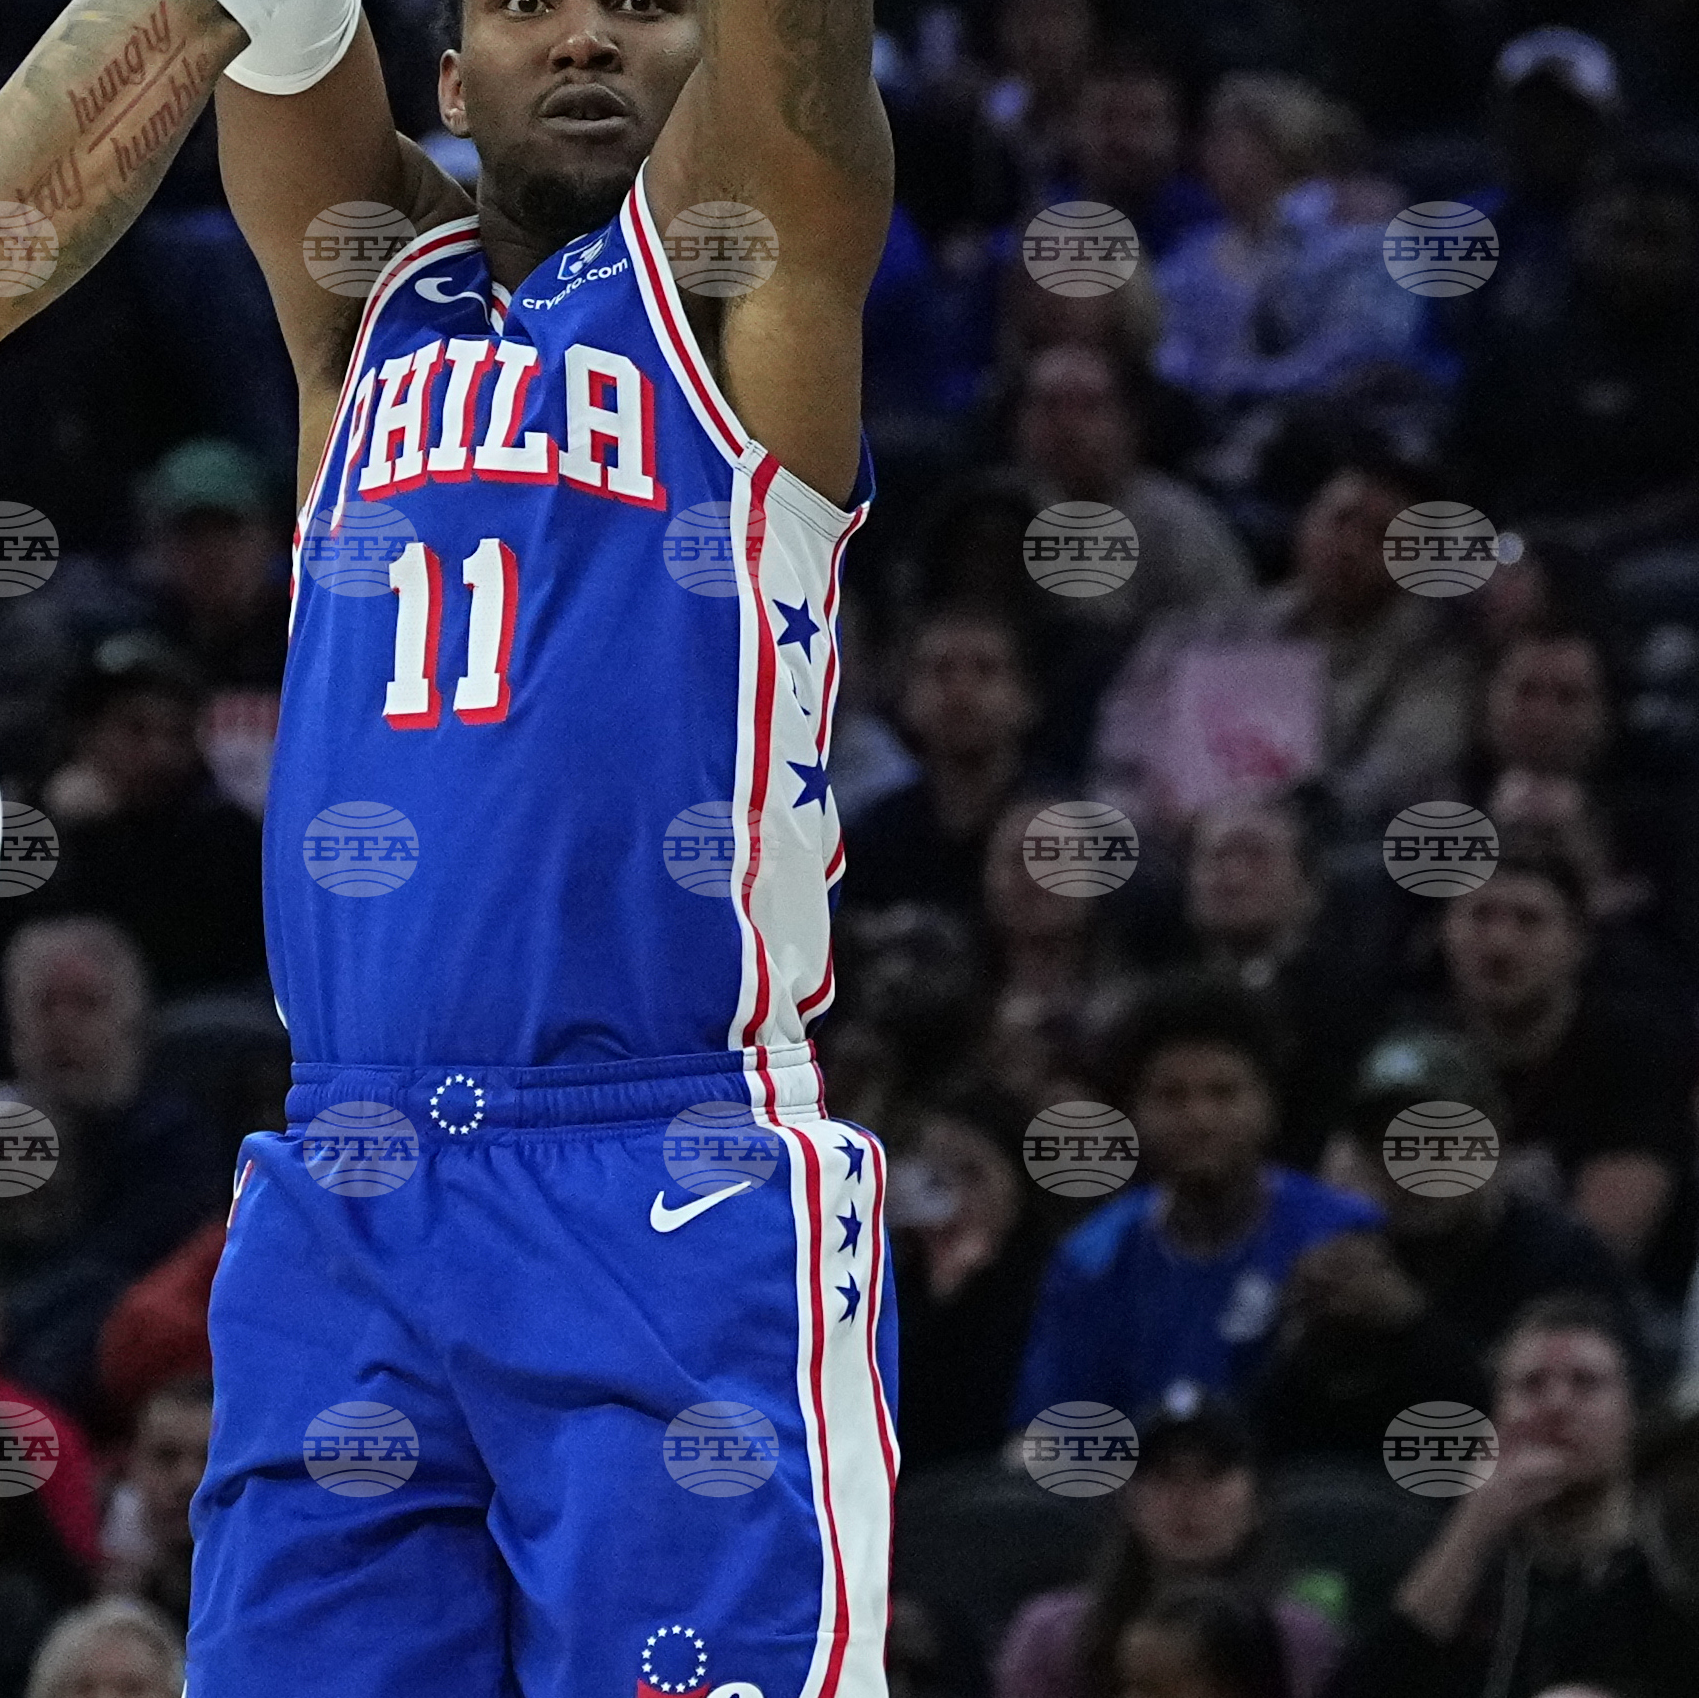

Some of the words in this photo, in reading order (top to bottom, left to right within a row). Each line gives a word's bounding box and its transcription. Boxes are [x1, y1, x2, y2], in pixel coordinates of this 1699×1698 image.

[66, 1, 173, 134] hungry
[110, 53, 209, 182] humble
[330, 335, 667, 539] PHILA
[381, 537, 519, 730] 11
